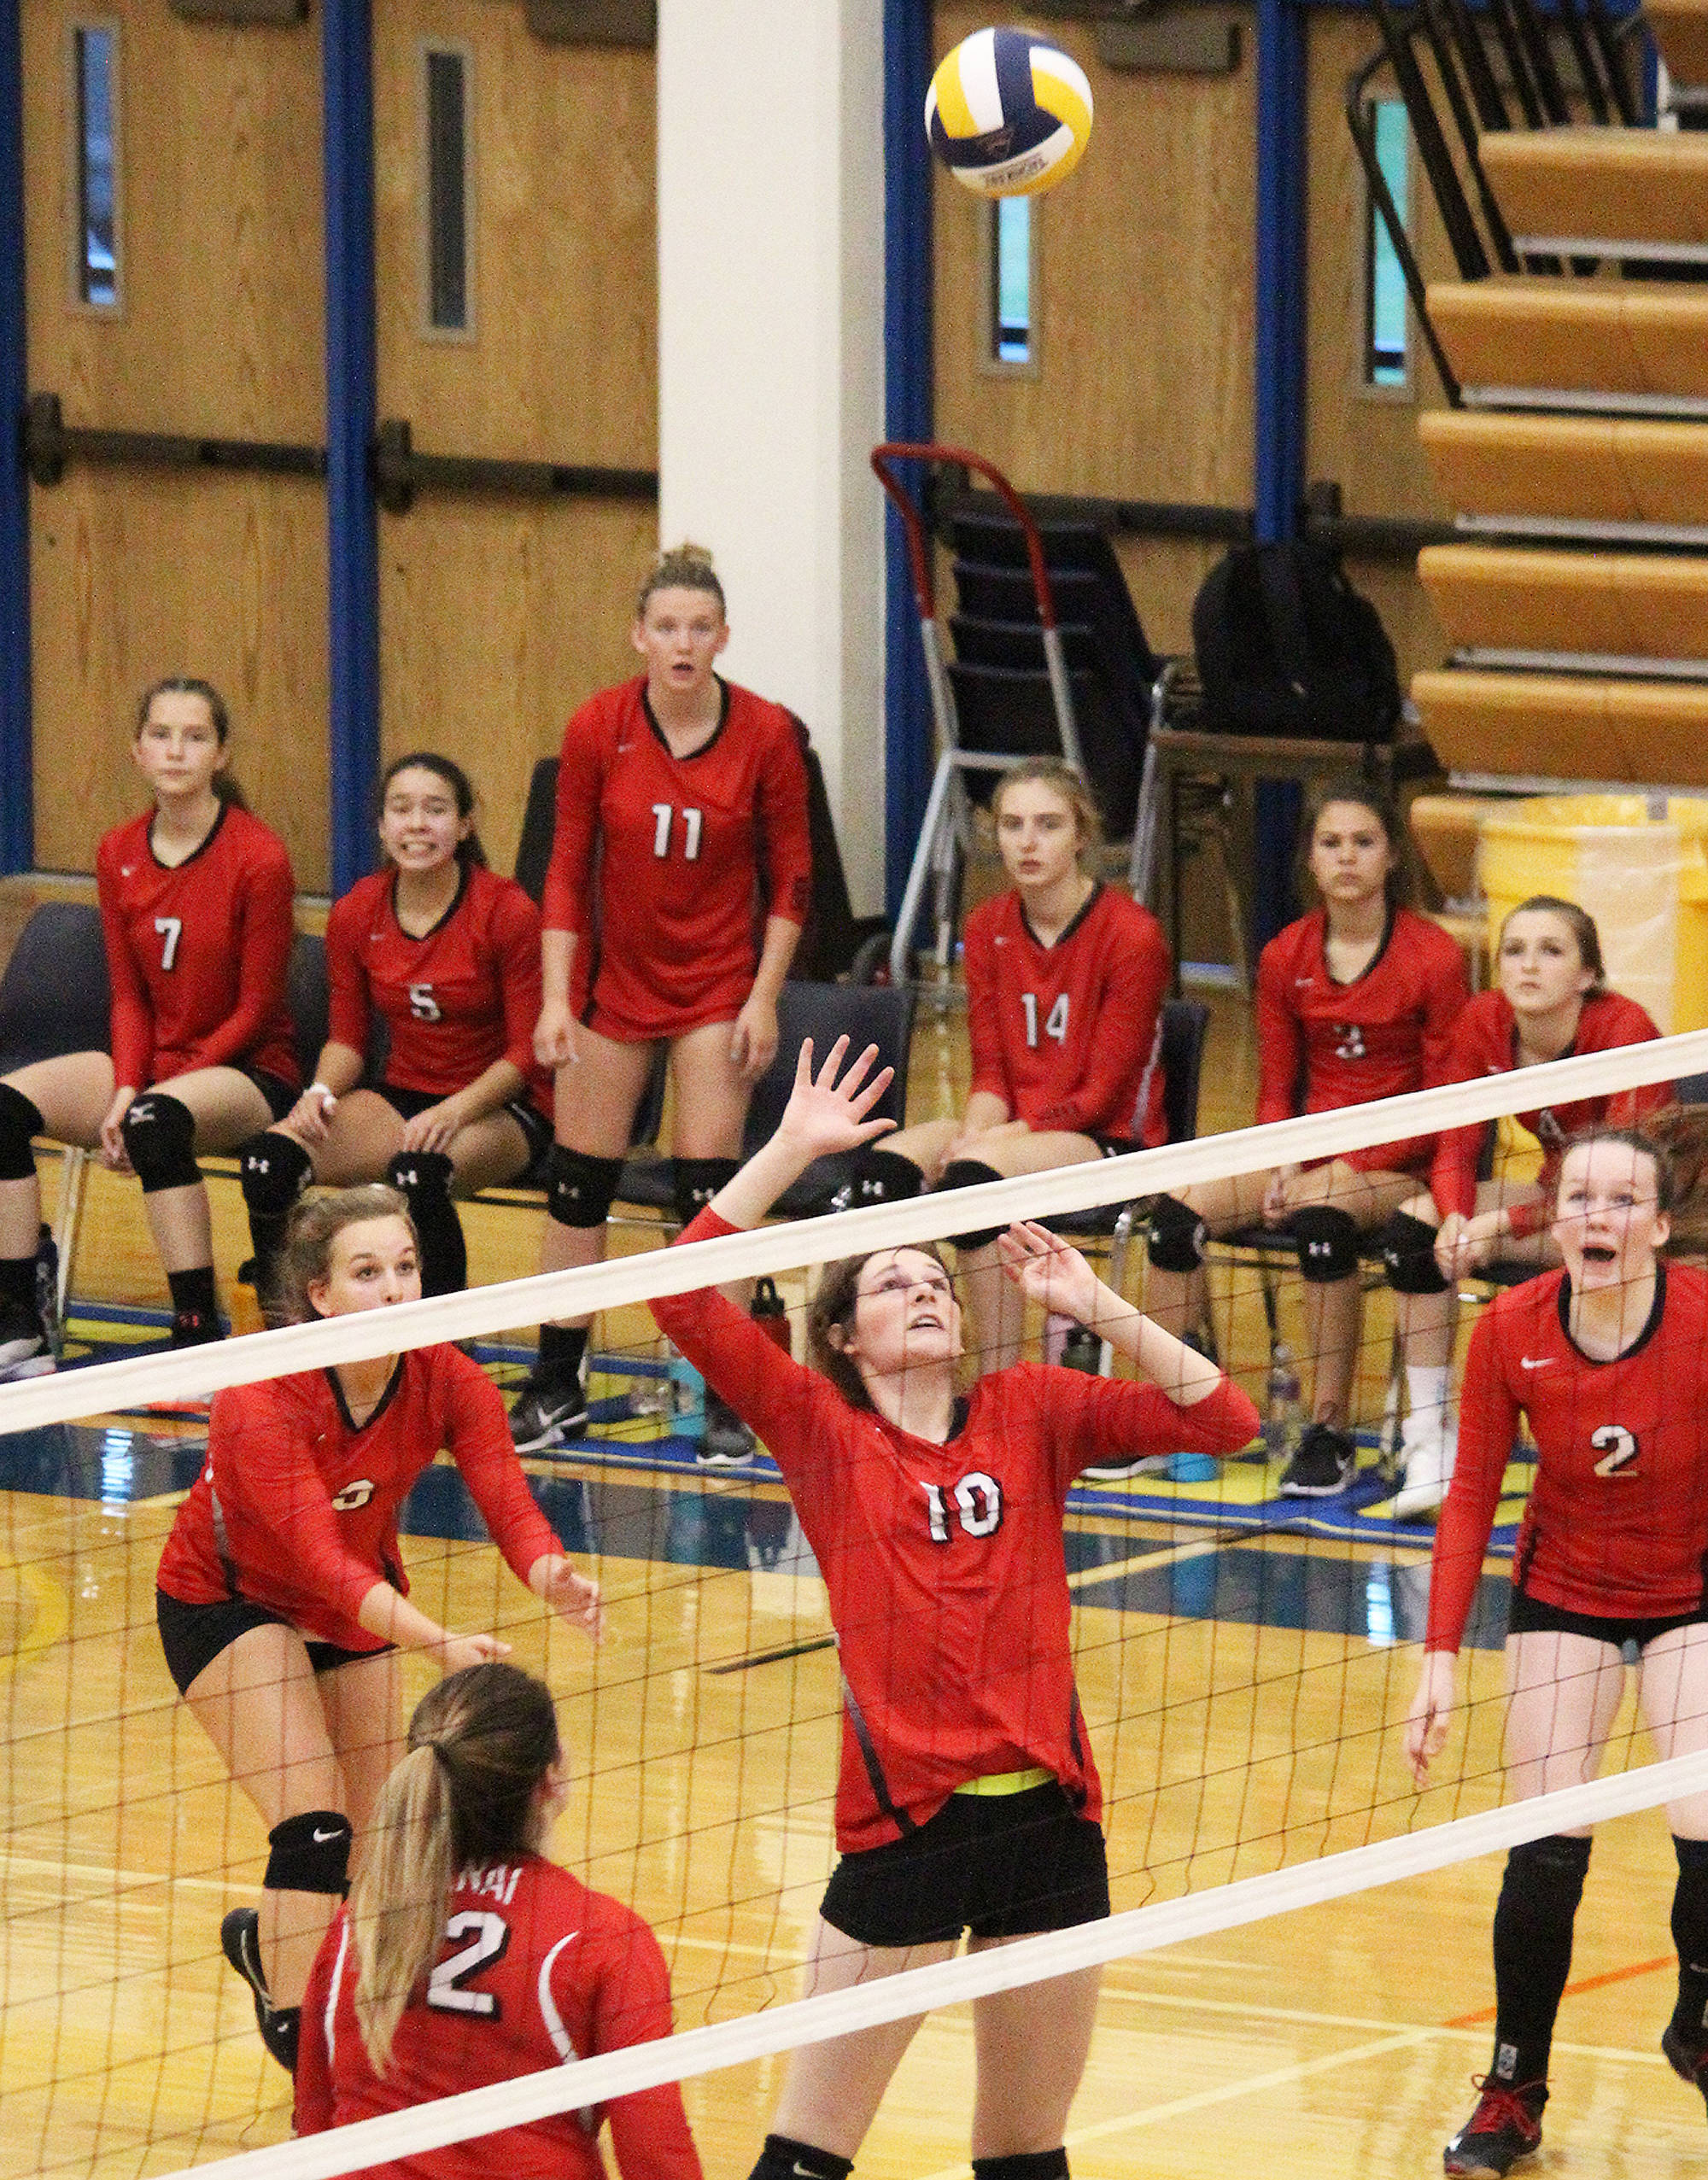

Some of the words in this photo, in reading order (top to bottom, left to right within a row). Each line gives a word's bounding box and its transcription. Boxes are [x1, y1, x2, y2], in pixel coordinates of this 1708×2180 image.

[652, 803, 703, 860] 11
[155, 916, 182, 970] 7
[410, 983, 442, 1021] 5
[1021, 992, 1068, 1048] 14
[1591, 1424, 1638, 1477] 2
[920, 1470, 1003, 1542] 10
[455, 1861, 524, 1905] NAI
[427, 1910, 510, 2017] 2
